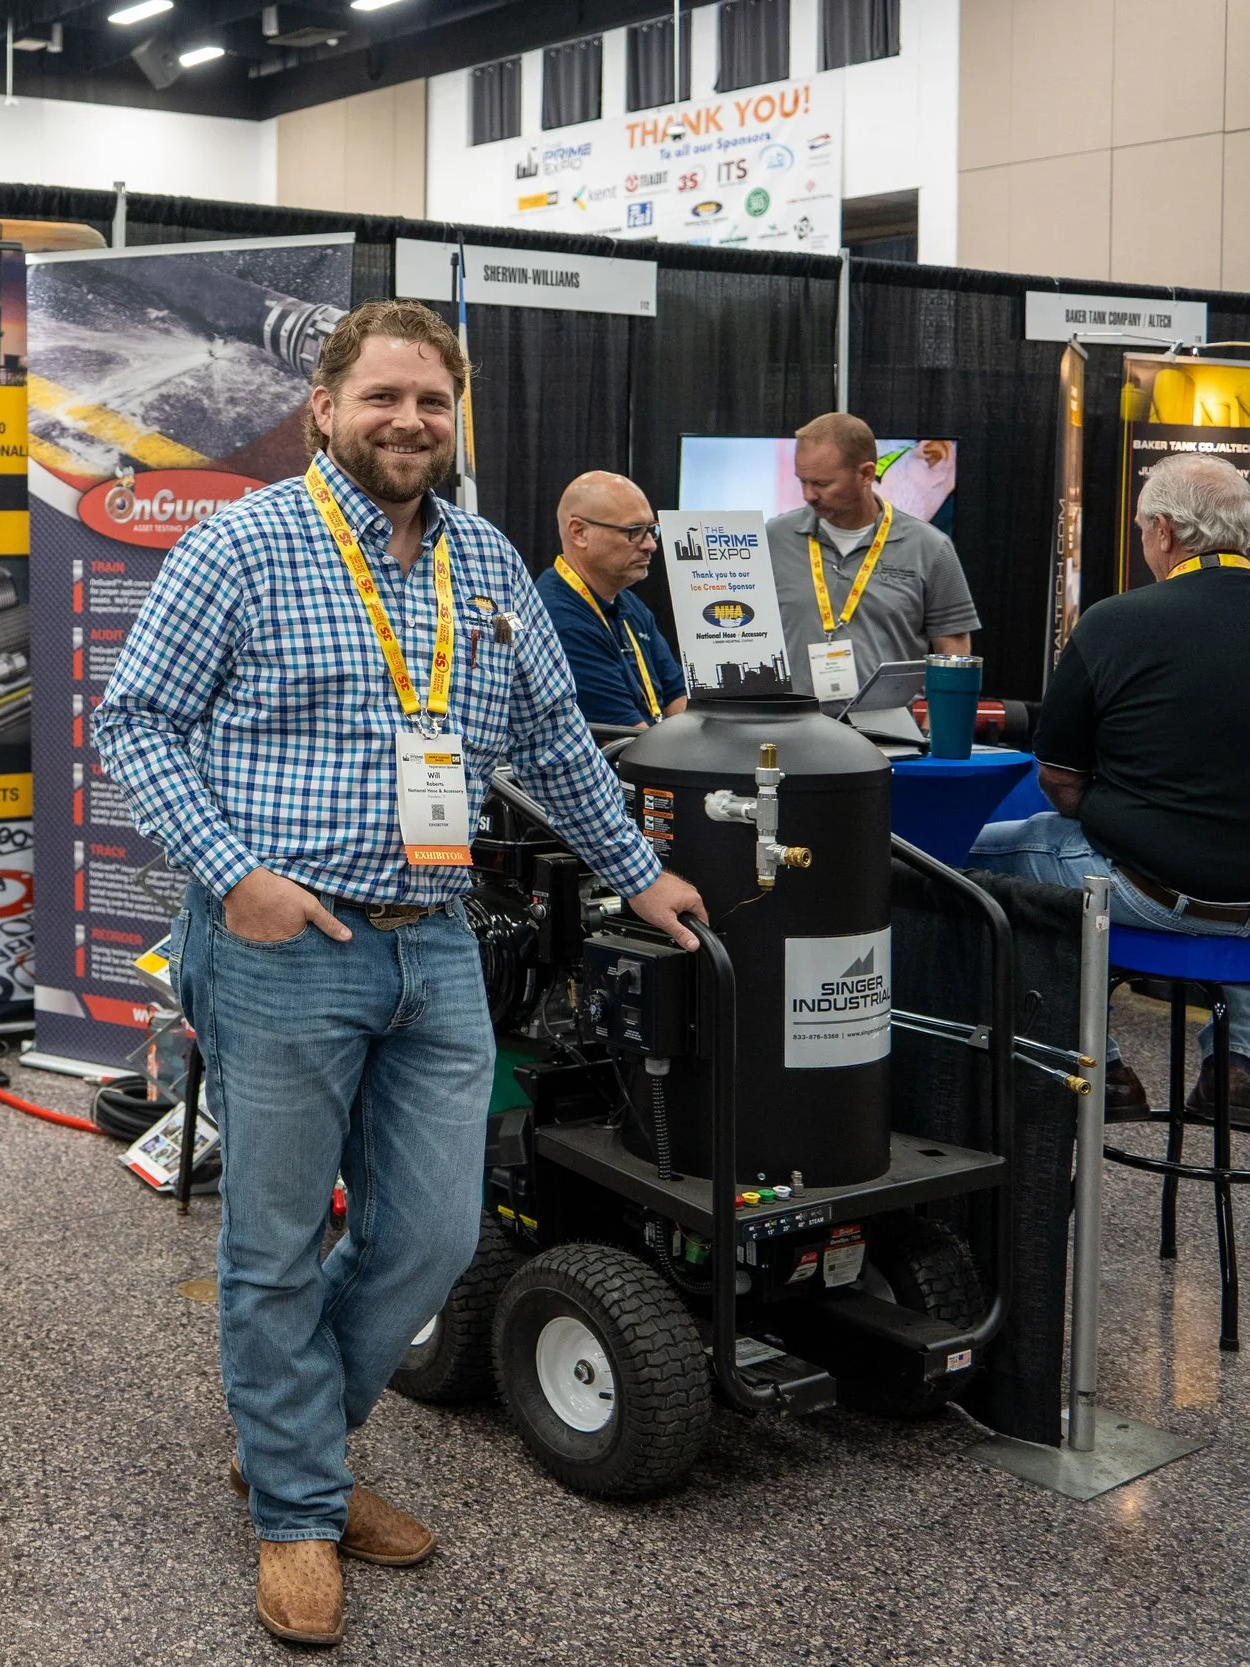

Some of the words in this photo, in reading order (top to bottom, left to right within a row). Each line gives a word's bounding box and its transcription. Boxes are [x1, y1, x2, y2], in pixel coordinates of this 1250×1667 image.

[626, 108, 723, 149] THANK
[733, 85, 811, 128] YOU!
[717, 131, 771, 153] Sponsors
[483, 264, 580, 289] SHERWIN-WILLIAMS
[1065, 308, 1087, 324] BAKER
[1089, 310, 1107, 325] TANK
[1108, 312, 1141, 328] COMPANY
[1148, 314, 1172, 329] ALTECH
[1132, 439, 1168, 451] BAKER
[1169, 441, 1198, 452] TANK
[1198, 441, 1250, 453] CO./ALTEC
[104, 486, 235, 525] OnGuar
[704, 526, 724, 534] THE
[706, 534, 759, 548] PRIME
[708, 548, 751, 561] EXPO
[692, 570, 714, 579] Thank
[714, 572, 728, 581] you
[690, 583, 702, 591] Ice
[703, 583, 727, 591] Cream
[728, 582, 756, 593] Sponsor
[715, 604, 744, 619] NHA
[696, 632, 721, 640] National
[741, 631, 768, 639] Accessory
[414, 851, 464, 861] EXHIBITOR
[821, 975, 883, 996] SINGER
[809, 1217, 824, 1226] STEAM
